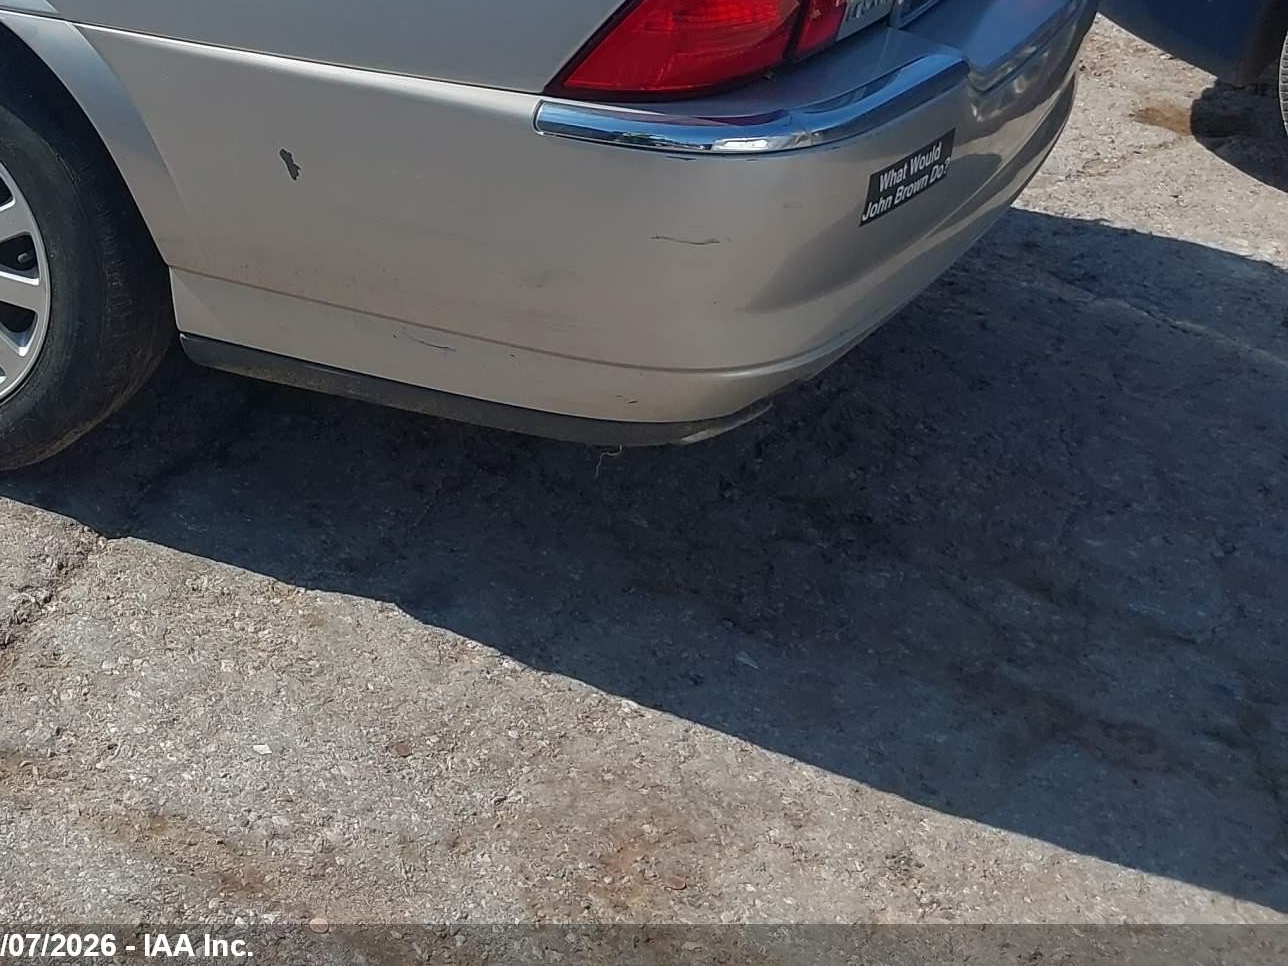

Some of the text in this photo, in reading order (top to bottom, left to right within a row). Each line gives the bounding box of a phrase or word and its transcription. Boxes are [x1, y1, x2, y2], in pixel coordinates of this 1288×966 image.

[861, 156, 952, 222] John Brown Do?
[879, 141, 942, 193] What Would
